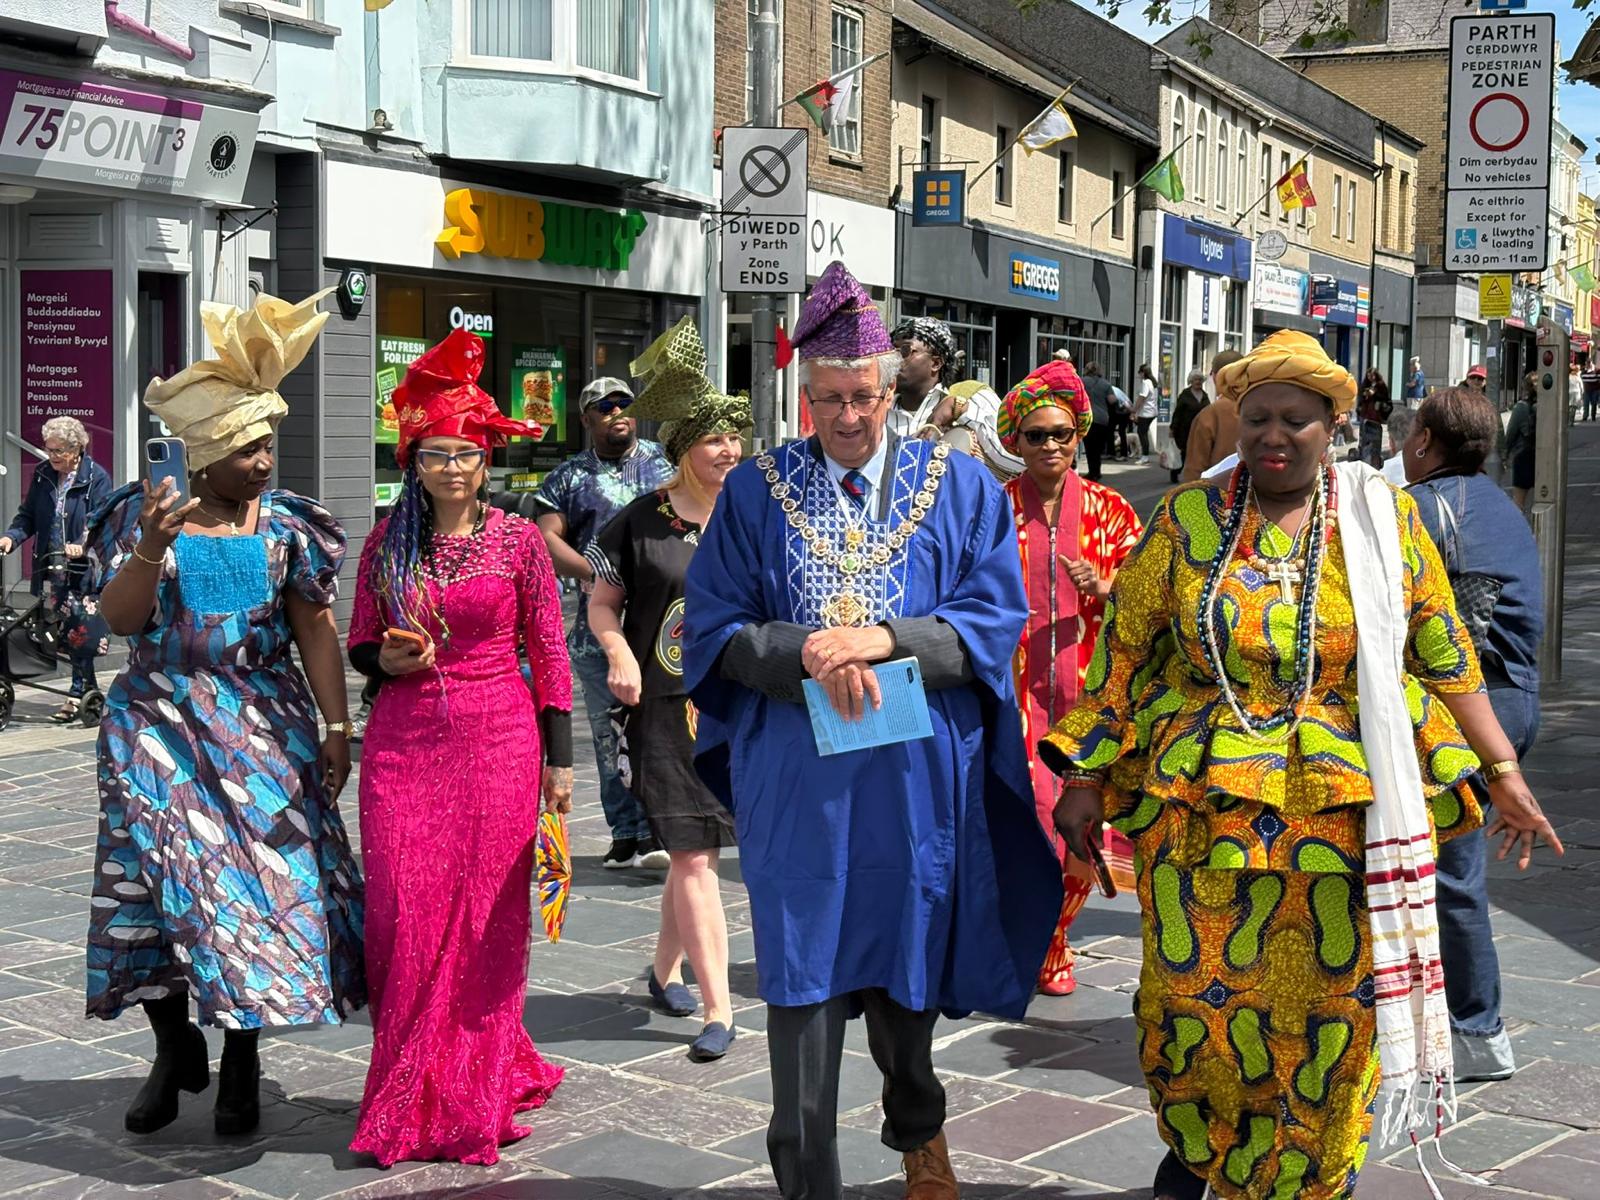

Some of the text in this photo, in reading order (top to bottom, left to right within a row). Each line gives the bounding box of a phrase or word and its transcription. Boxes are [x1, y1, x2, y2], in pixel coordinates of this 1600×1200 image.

[1469, 24, 1536, 41] PARTH
[1466, 43, 1538, 55] CERDDWYR
[1461, 60, 1541, 71] PEDESTRIAN
[1472, 72, 1529, 88] ZONE
[17, 80, 125, 106] Mortgages and Financial Advice
[1459, 156, 1538, 168] Dim cerbydau
[1465, 172, 1532, 182] No vehicles
[1469, 195, 1525, 206] Ac eithrio
[1466, 211, 1527, 223] Except for
[434, 187, 648, 271] SUBWAY
[729, 221, 800, 235] DIWEDD
[1492, 227, 1535, 238] llwytho
[1481, 233, 1489, 242] &
[740, 239, 788, 250] y Parth
[1492, 239, 1534, 249] loading
[749, 258, 780, 268] Zone
[1452, 254, 1480, 264] 4.30
[1482, 256, 1500, 265] pm
[1509, 253, 1519, 263] 11
[1521, 255, 1538, 263] am
[740, 272, 789, 284] ENDS
[1022, 261, 1060, 293] GREGGS
[27, 293, 68, 304] Morgeisi
[27, 306, 101, 317] Buddsoddiadau
[450, 306, 493, 331] Open
[27, 321, 76, 332] Pensiynau
[27, 335, 108, 348] Yswiriant Bywyd
[381, 340, 425, 354] EAT FRESH
[384, 352, 401, 363] FOR
[27, 363, 78, 375] Mortgages
[27, 378, 83, 388] Investments
[27, 392, 69, 402] Pensions
[27, 405, 94, 416] Life Assurance
